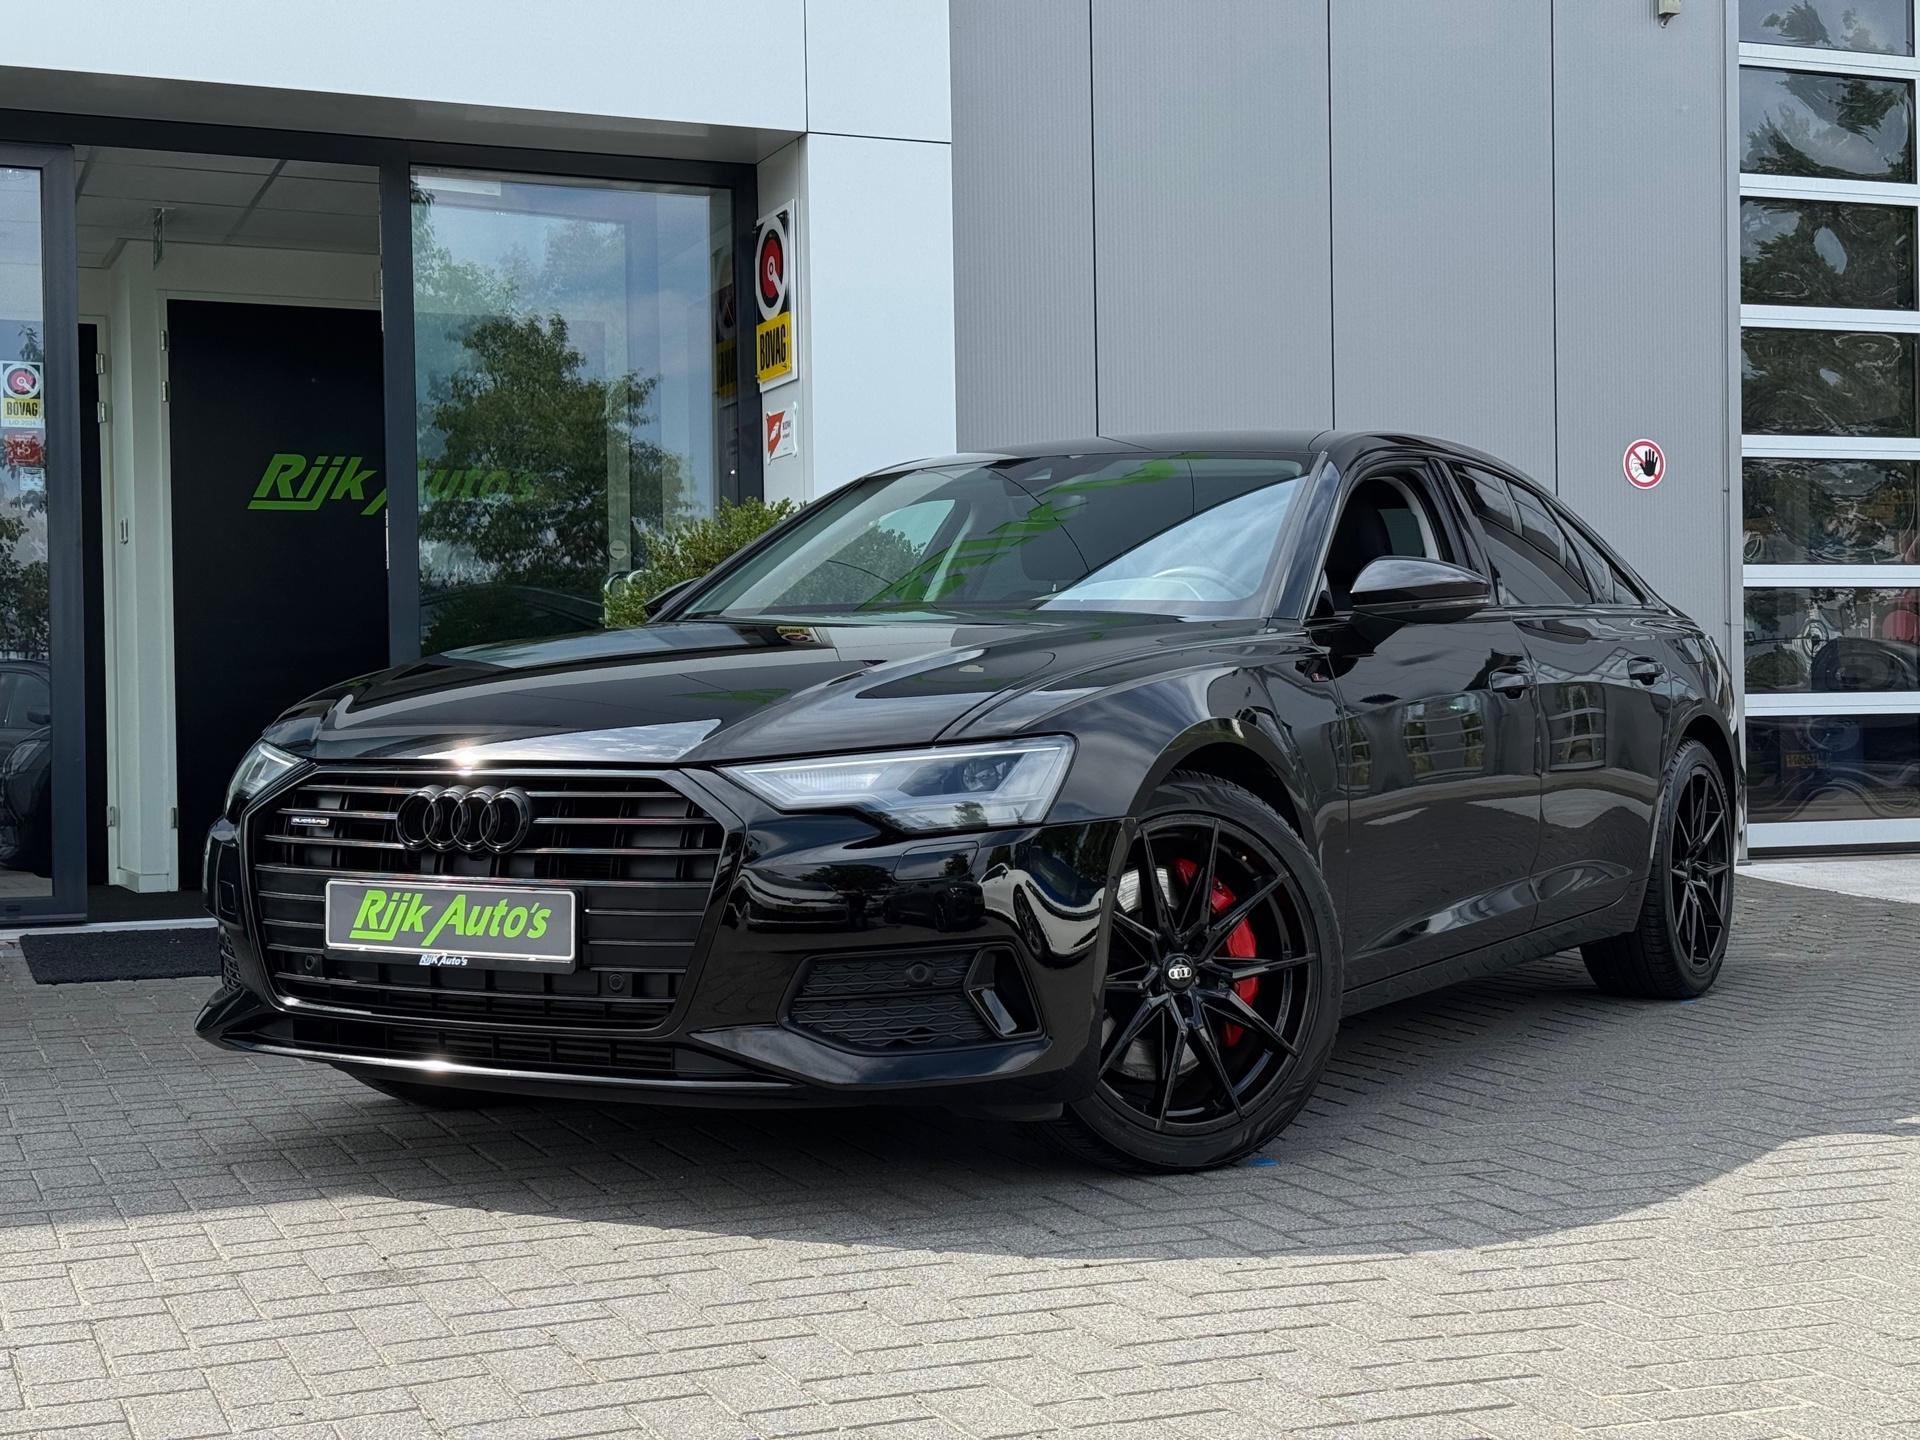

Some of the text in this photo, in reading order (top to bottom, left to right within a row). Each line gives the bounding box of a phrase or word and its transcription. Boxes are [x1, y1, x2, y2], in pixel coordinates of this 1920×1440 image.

[760, 323, 786, 371] BOVAG
[6, 401, 38, 417] BOVAG
[247, 453, 378, 511] Rijk
[349, 890, 552, 947] Rijk Auto's
[438, 956, 468, 967] Auto's
